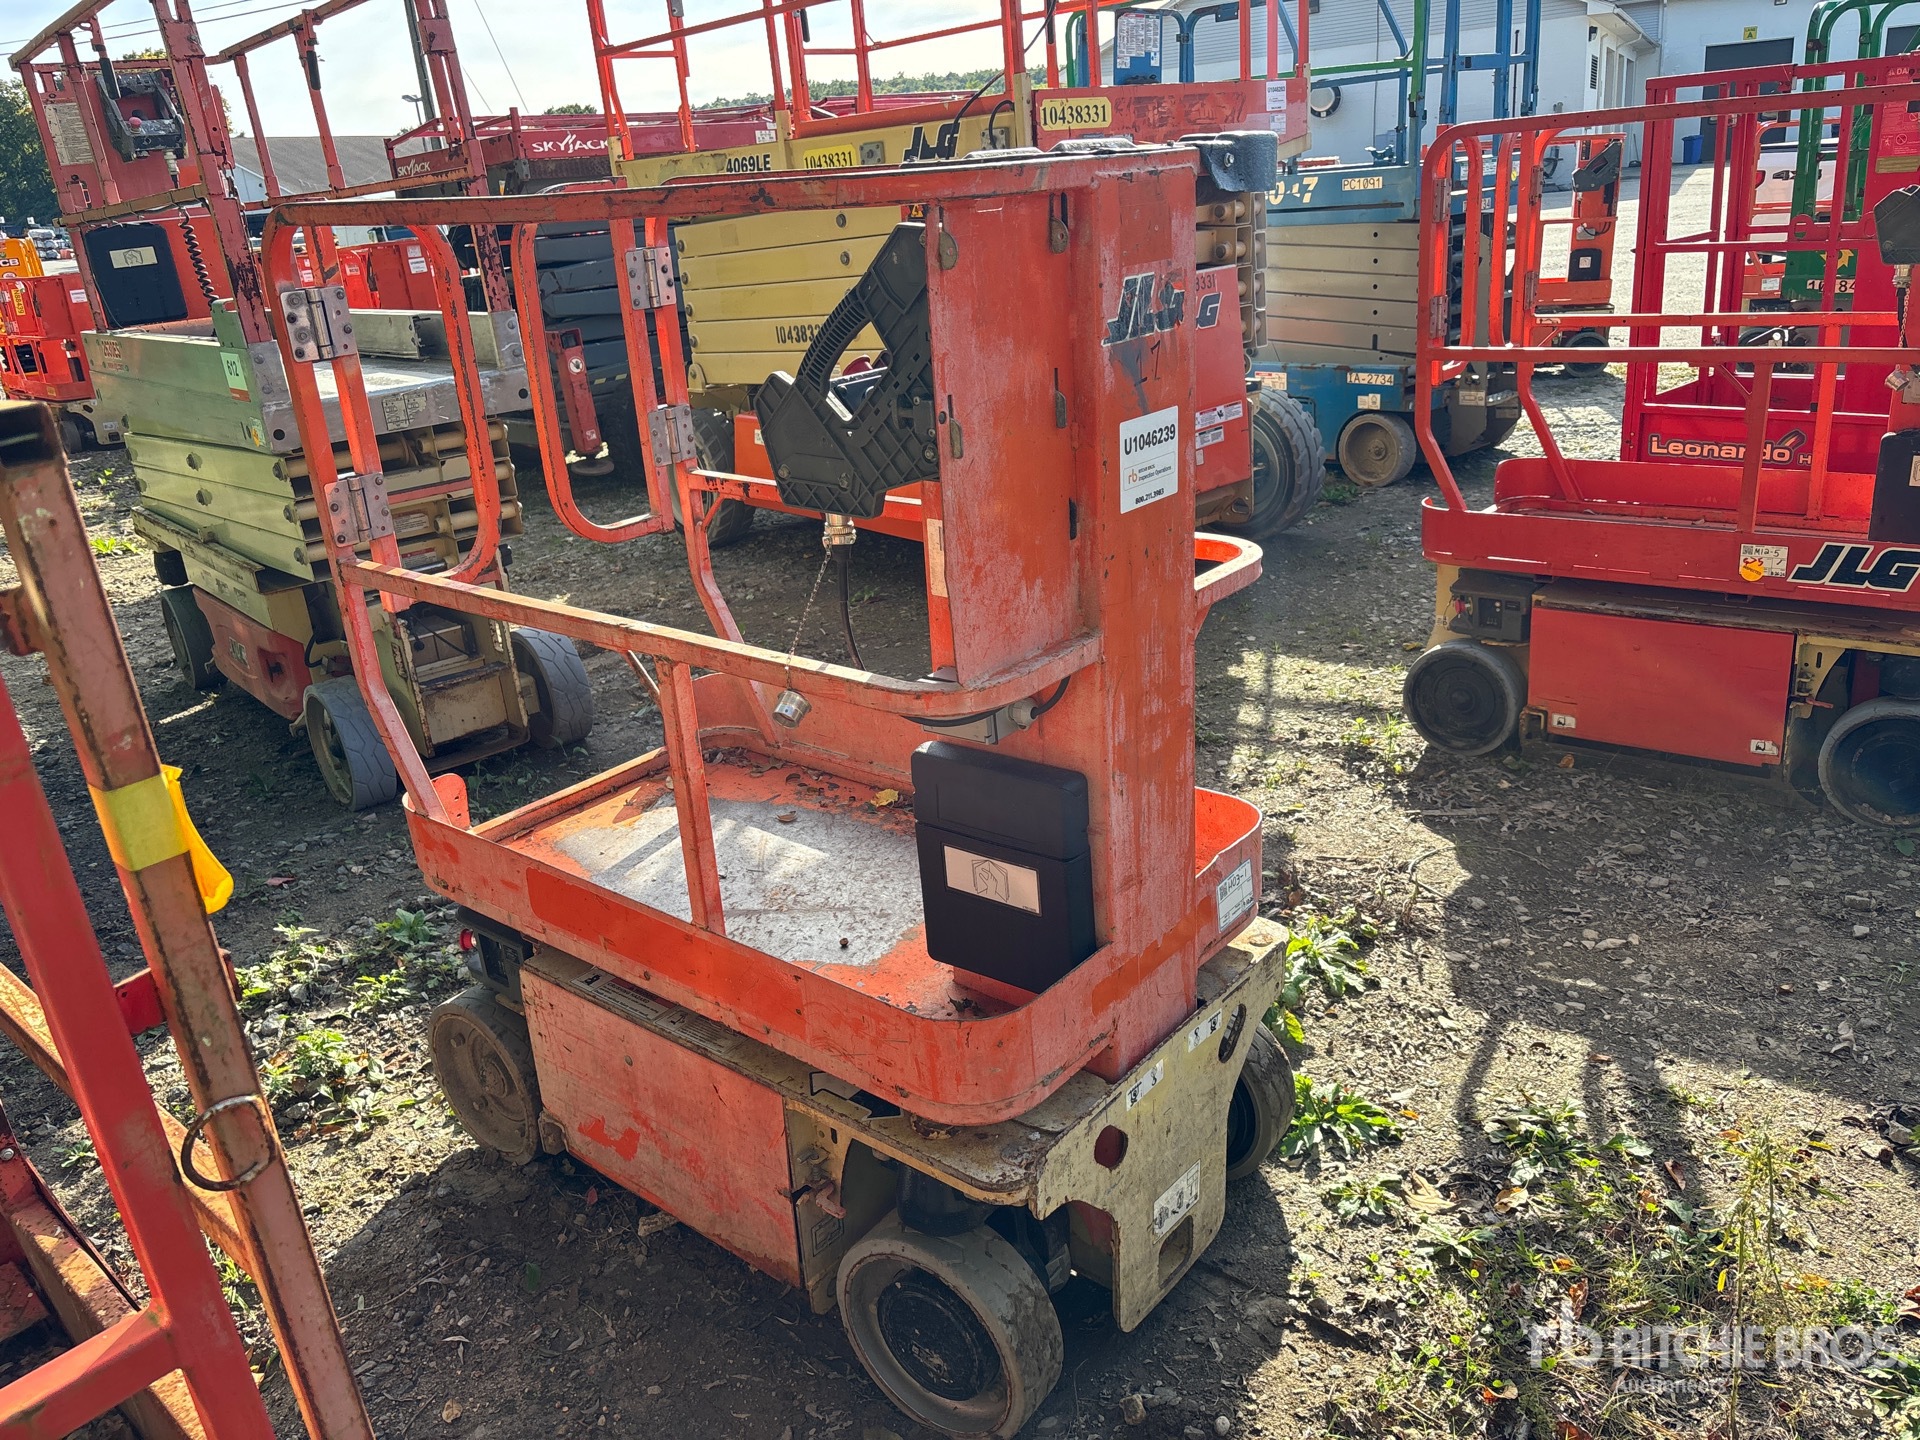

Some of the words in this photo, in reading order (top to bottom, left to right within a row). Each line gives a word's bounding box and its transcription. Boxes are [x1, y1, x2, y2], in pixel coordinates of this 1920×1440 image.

[1041, 104, 1108, 126] 10438331
[531, 131, 608, 154] SKYJACK
[902, 121, 961, 161] JLG
[397, 158, 431, 177] SKYJACK
[726, 153, 772, 173] 4069LE
[804, 151, 853, 168] 10438331
[1343, 177, 1381, 190] PC1091
[1101, 271, 1185, 347] JLG
[775, 324, 821, 344] 104383
[226, 360, 240, 377] 612
[1347, 372, 1393, 385] IA-2734
[1124, 424, 1176, 456] U1046239
[1787, 541, 1920, 593] JLG
